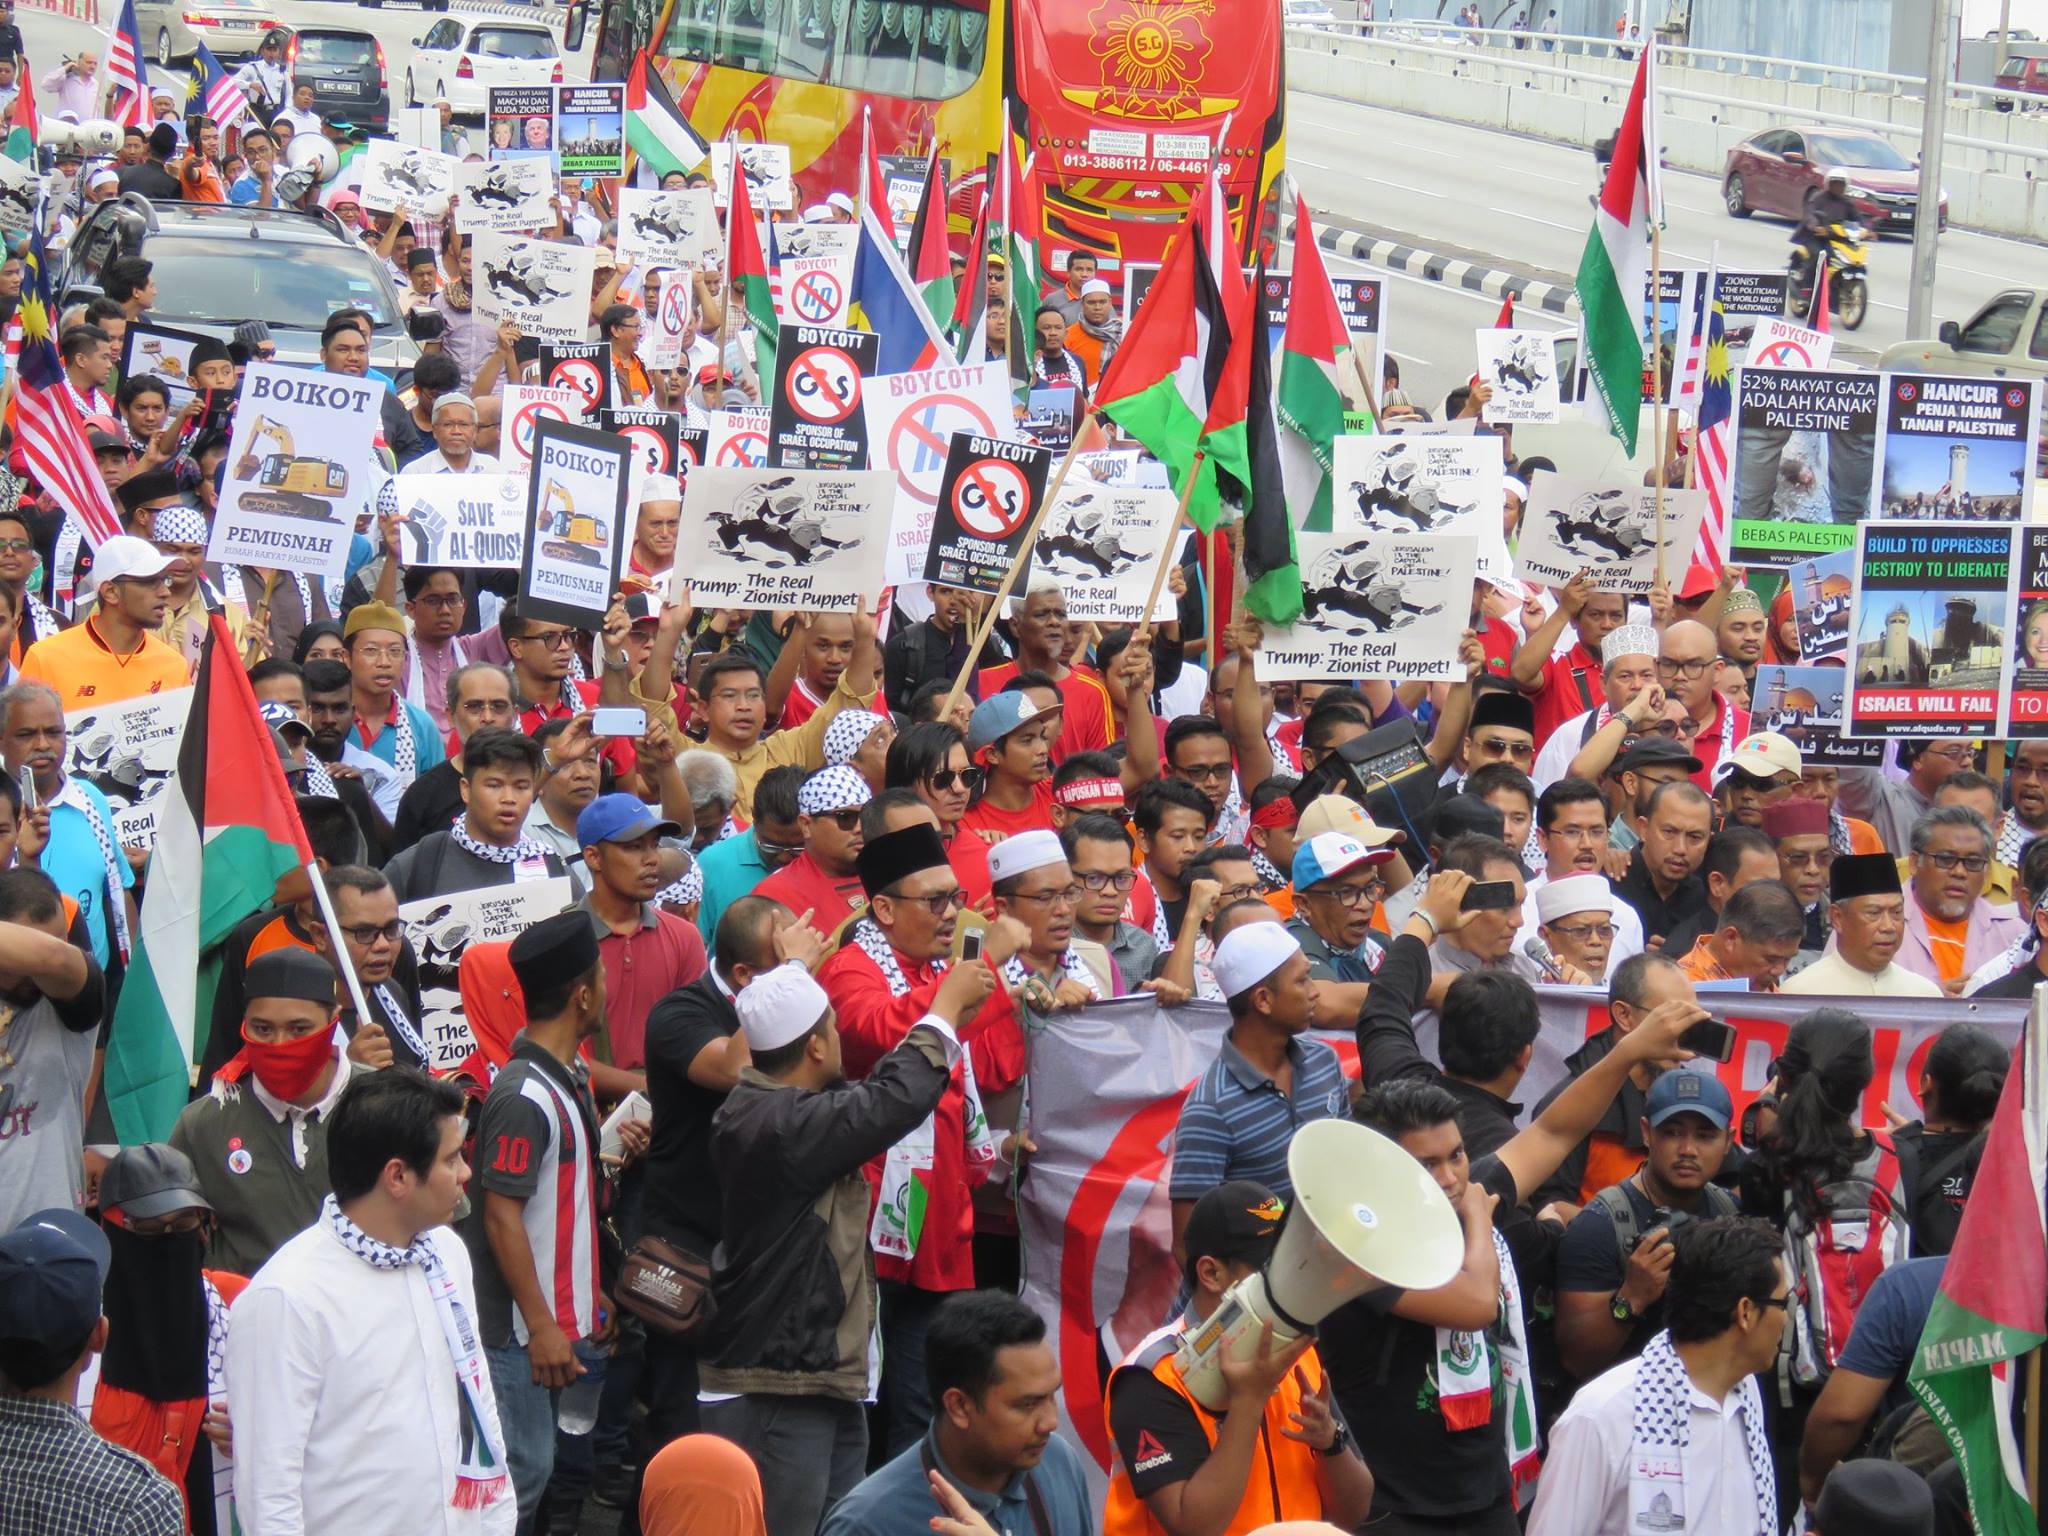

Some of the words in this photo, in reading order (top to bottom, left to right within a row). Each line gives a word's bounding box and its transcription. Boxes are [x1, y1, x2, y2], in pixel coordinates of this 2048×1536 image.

[574, 90, 608, 98] HANCUR
[519, 105, 550, 113] ZIONIST
[1064, 154, 1146, 171] 013-3886112
[1157, 160, 1231, 175] 06-446159
[892, 182, 922, 194] BOIK
[491, 213, 505, 221] The
[507, 212, 523, 220] Real
[492, 221, 517, 229] Zionist
[648, 247, 660, 255] The
[662, 248, 679, 256] Real
[794, 258, 838, 270] BOYCOTT
[1725, 276, 1760, 286] ZIONIST
[1733, 295, 1759, 303] WORLD
[1740, 287, 1779, 296] POLITICIAN
[502, 308, 517, 319] The
[521, 312, 543, 322] Real
[1737, 304, 1777, 313] NATIONALS
[507, 322, 533, 333] onist
[536, 325, 577, 337] Puppet!
[1771, 321, 1821, 347] BOYCOTT
[798, 328, 864, 349] BOYCOTT
[553, 346, 600, 358] BOYCOTT
[889, 366, 985, 398] BOYCOTT
[1742, 374, 1777, 391] 52%
[1781, 378, 1833, 395] RAKYAT
[1836, 381, 1875, 396] GAZA
[252, 376, 371, 413] BOIKOT
[520, 387, 571, 402] BOYCOTT
[1742, 391, 1812, 409] ADALAH
[1922, 383, 1998, 404] HANCUR
[1509, 399, 1520, 408] The
[1521, 399, 1534, 408] Real
[614, 411, 667, 426] BOYCOTT
[728, 415, 769, 431] BOYCO
[1766, 411, 1850, 431] PALESTINE
[1900, 417, 1944, 433] TANAH
[1948, 419, 2017, 437] PALESTINE
[680, 430, 701, 440] COTT
[795, 424, 832, 439] SPONSOR
[834, 427, 844, 438] OF
[779, 434, 808, 447] ISRAEL
[809, 437, 858, 452] OCCUPATION
[970, 437, 1037, 464] BOYCOTT
[543, 446, 616, 480] BOIKOT
[457, 500, 496, 527] SAVE
[813, 502, 872, 513] PALESTINE!
[227, 526, 333, 554] PEMUSNAH
[896, 529, 931, 547] ISRAE
[957, 536, 995, 553] SPONSOR
[997, 544, 1008, 556] OF
[1741, 528, 1785, 544] BEBAS
[1789, 531, 1854, 547] PALESTIN
[1868, 537, 1906, 555] BUILD
[1911, 538, 1927, 553] TO
[1931, 538, 2008, 554] OPPRESSES
[224, 546, 253, 557] RUMAH
[255, 548, 287, 562] RAKYAT
[449, 531, 522, 564] AL-QUDS!
[939, 545, 968, 562] ISRAEL
[970, 551, 1014, 569] OCCUPATIO
[1391, 567, 1451, 577] PALESTINE!
[1604, 566, 1632, 577] Real
[1864, 561, 1923, 578] DESTROY
[1927, 562, 1944, 578] TO
[1947, 562, 2008, 578] LIBERATE
[537, 569, 604, 594] PEMUSNAH
[683, 578, 743, 595] Trump:
[747, 573, 775, 588] The
[779, 575, 814, 589] Real
[743, 590, 796, 605] Zionist
[1063, 586, 1086, 600] The
[1089, 587, 1117, 600] Real
[1329, 642, 1358, 656] The
[1362, 643, 1396, 657] Real
[1265, 650, 1324, 667] Trump:
[1326, 659, 1382, 673] Zionist
[1386, 660, 1450, 677] Puppet!
[1858, 696, 1912, 712] ISRAEL
[1916, 696, 1955, 712] WILL
[1960, 696, 1993, 712] FAIL
[2018, 697, 2041, 714] TO
[136, 716, 151, 724] THE
[1886, 724, 1961, 734] www.alquds.my
[1824, 734, 1880, 756] عاصمة
[1062, 783, 1101, 803] HAPUSKAN
[121, 812, 155, 834] Real
[478, 897, 526, 911] JERUSALEM
[483, 912, 523, 923] CAPITAL
[435, 1023, 468, 1043] The
[438, 1042, 477, 1062] Zion
[491, 1135, 531, 1174] 10
[1134, 1453, 1173, 1473] Reebok
